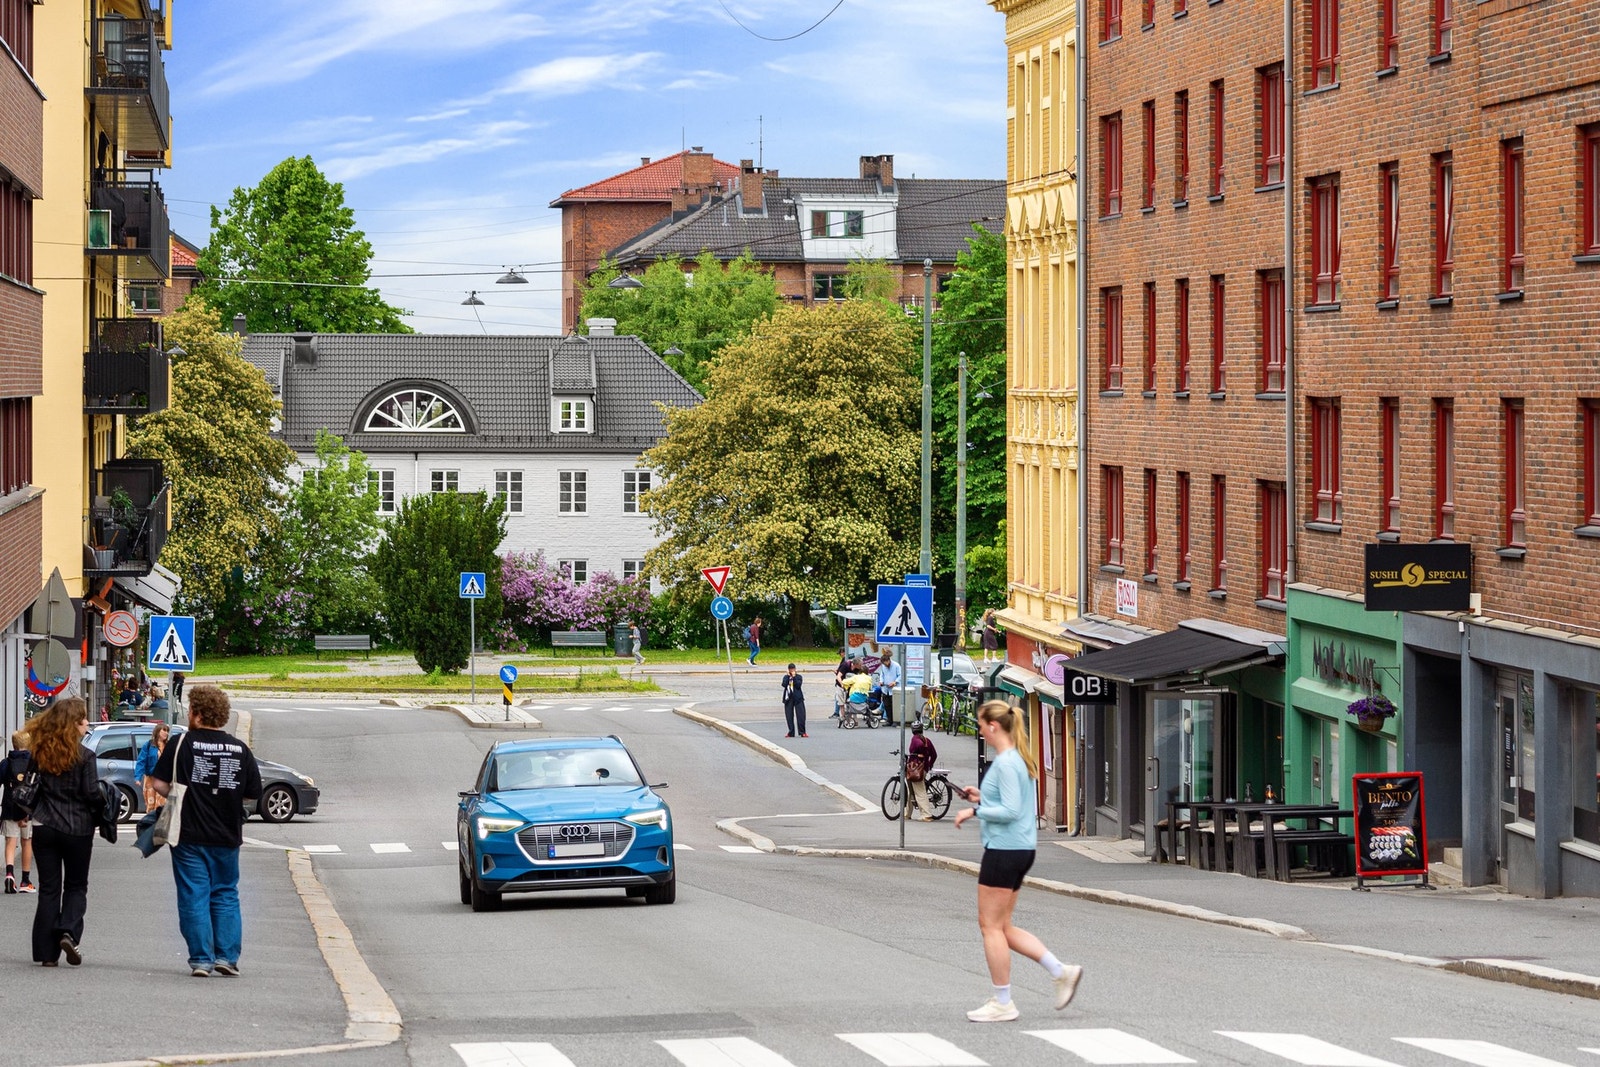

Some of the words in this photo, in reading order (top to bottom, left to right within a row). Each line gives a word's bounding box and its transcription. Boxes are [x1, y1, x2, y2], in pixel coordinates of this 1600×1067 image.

[1370, 571, 1398, 579] SUSHI
[1428, 571, 1467, 579] SPECIAL
[943, 658, 951, 668] P
[1072, 676, 1101, 696] OB
[225, 744, 242, 753] TOUR
[1368, 791, 1412, 804] BENTO
